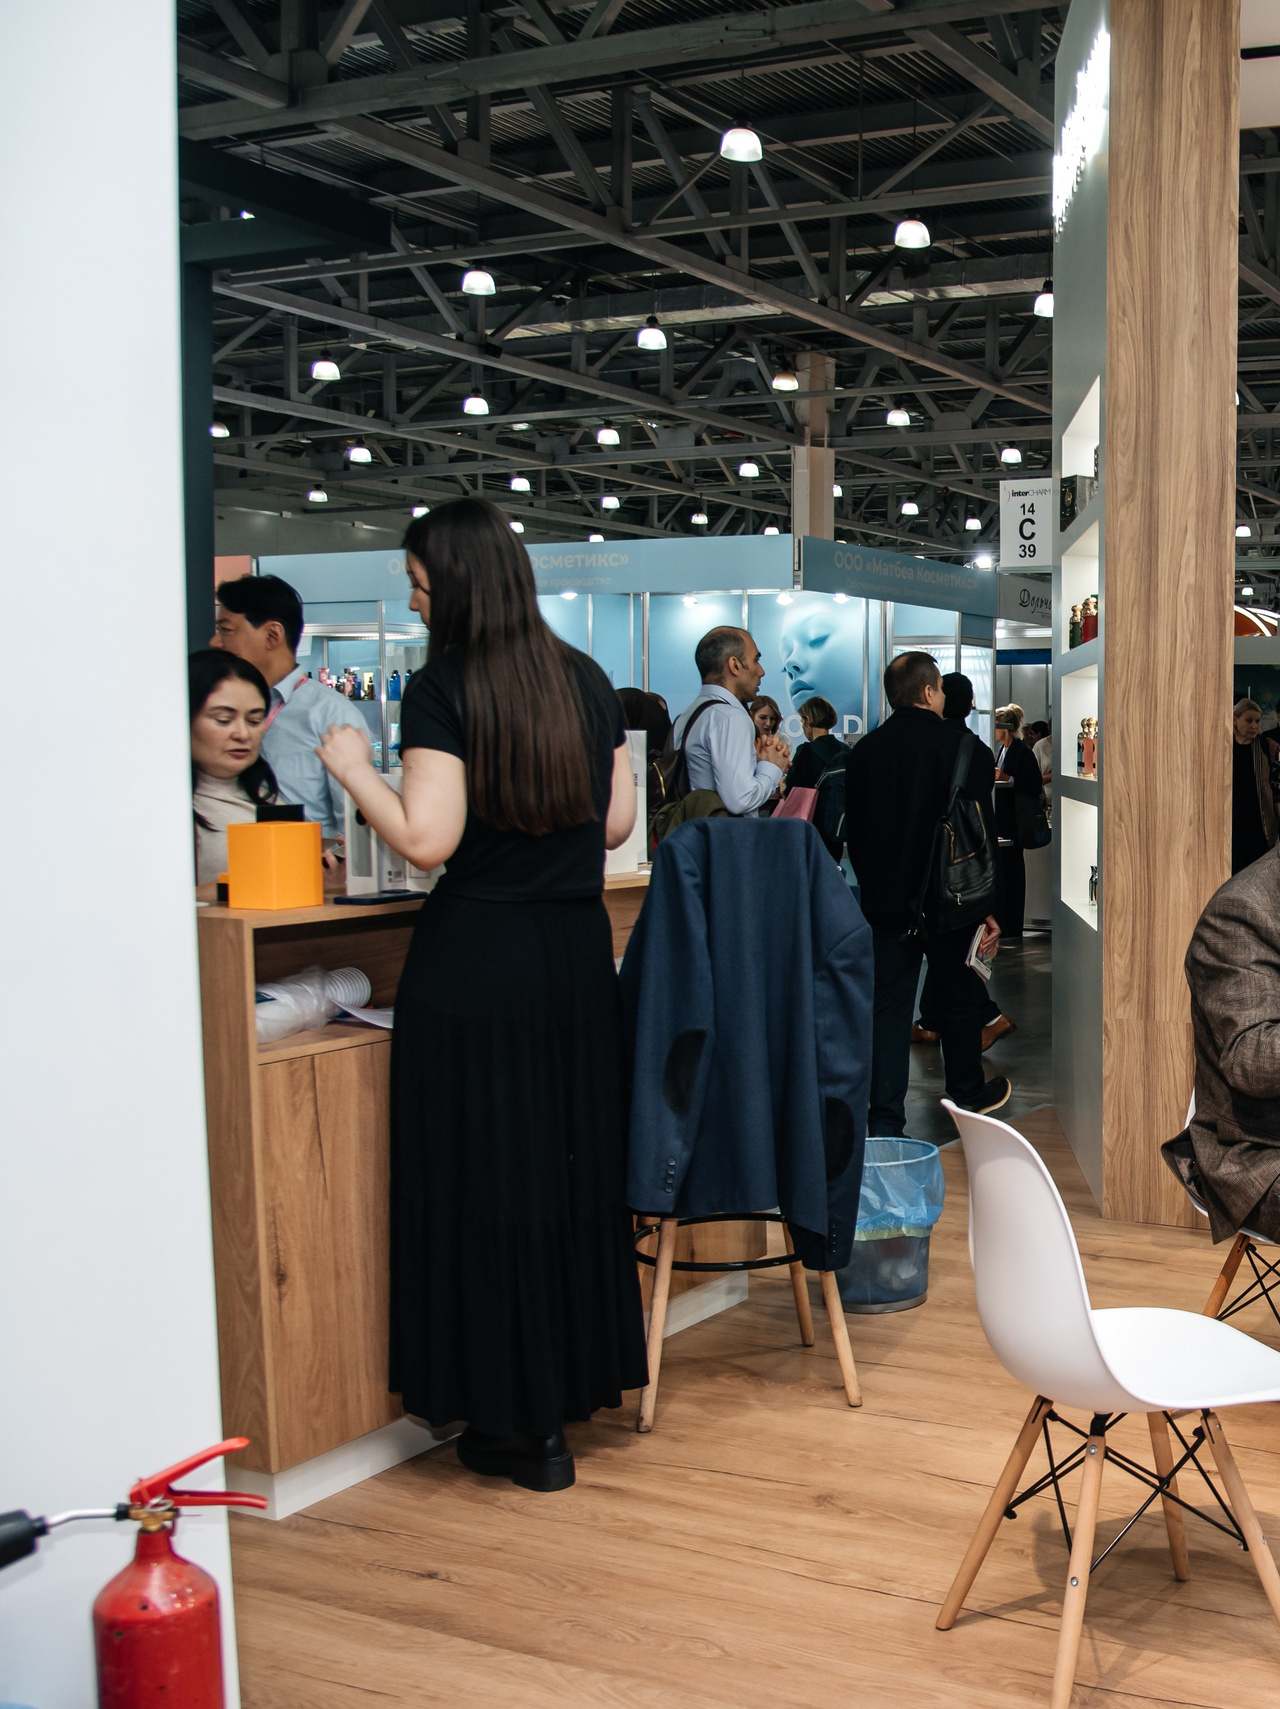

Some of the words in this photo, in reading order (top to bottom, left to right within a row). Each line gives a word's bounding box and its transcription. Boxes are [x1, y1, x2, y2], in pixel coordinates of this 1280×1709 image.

[1011, 488, 1052, 498] interCHARM
[1020, 502, 1036, 516] 14
[1018, 518, 1036, 541] C
[1018, 544, 1036, 558] 39
[530, 551, 629, 570] осметикс»
